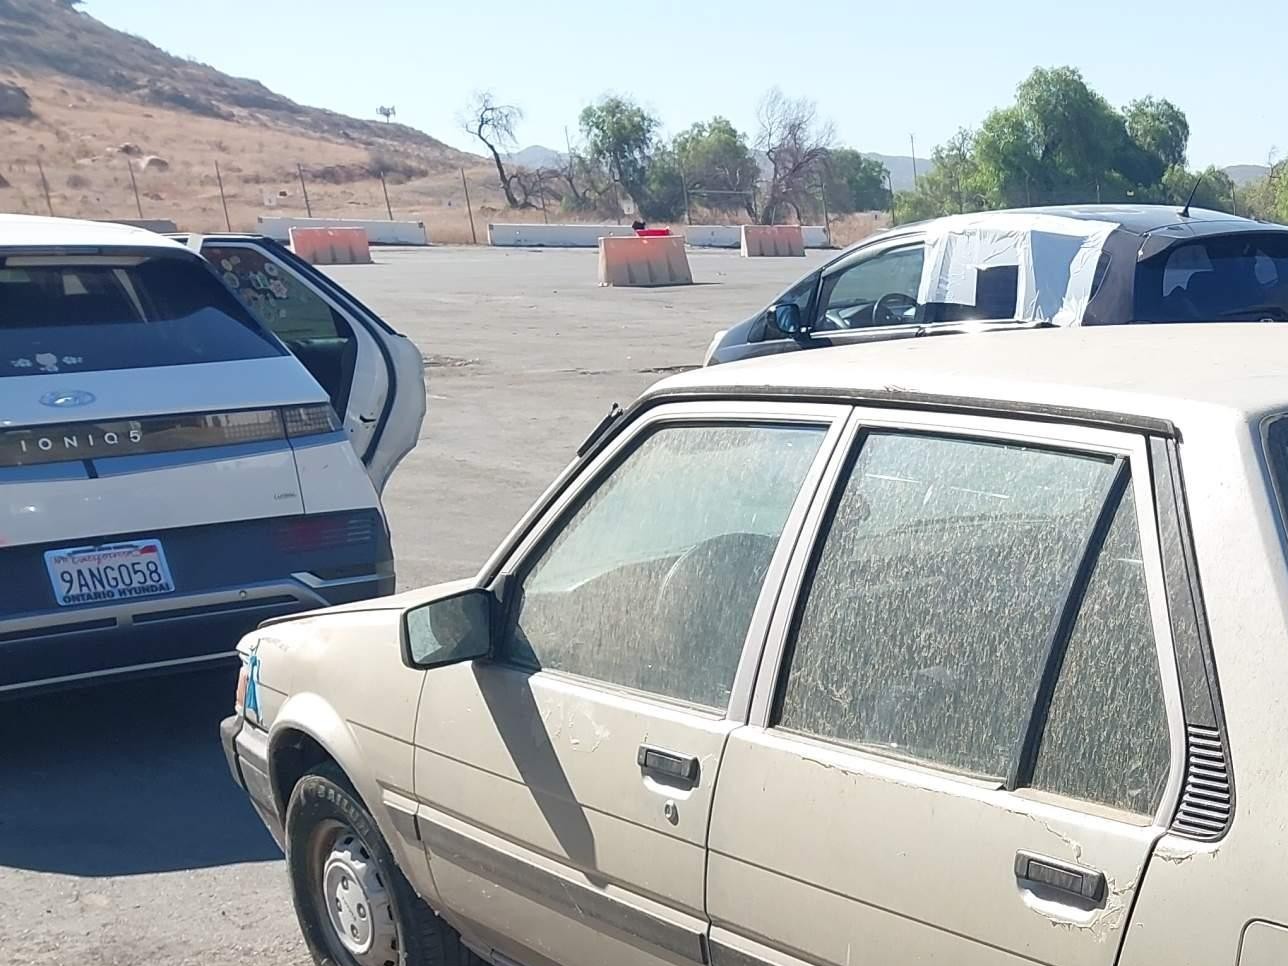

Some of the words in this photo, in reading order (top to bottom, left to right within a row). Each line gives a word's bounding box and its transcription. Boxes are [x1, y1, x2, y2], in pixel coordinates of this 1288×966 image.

[20, 431, 119, 453] IONIQ
[129, 429, 142, 443] 5
[60, 560, 162, 595] 9ANG058
[62, 590, 115, 604] ONTARIO
[119, 582, 170, 598] HYUNDAI
